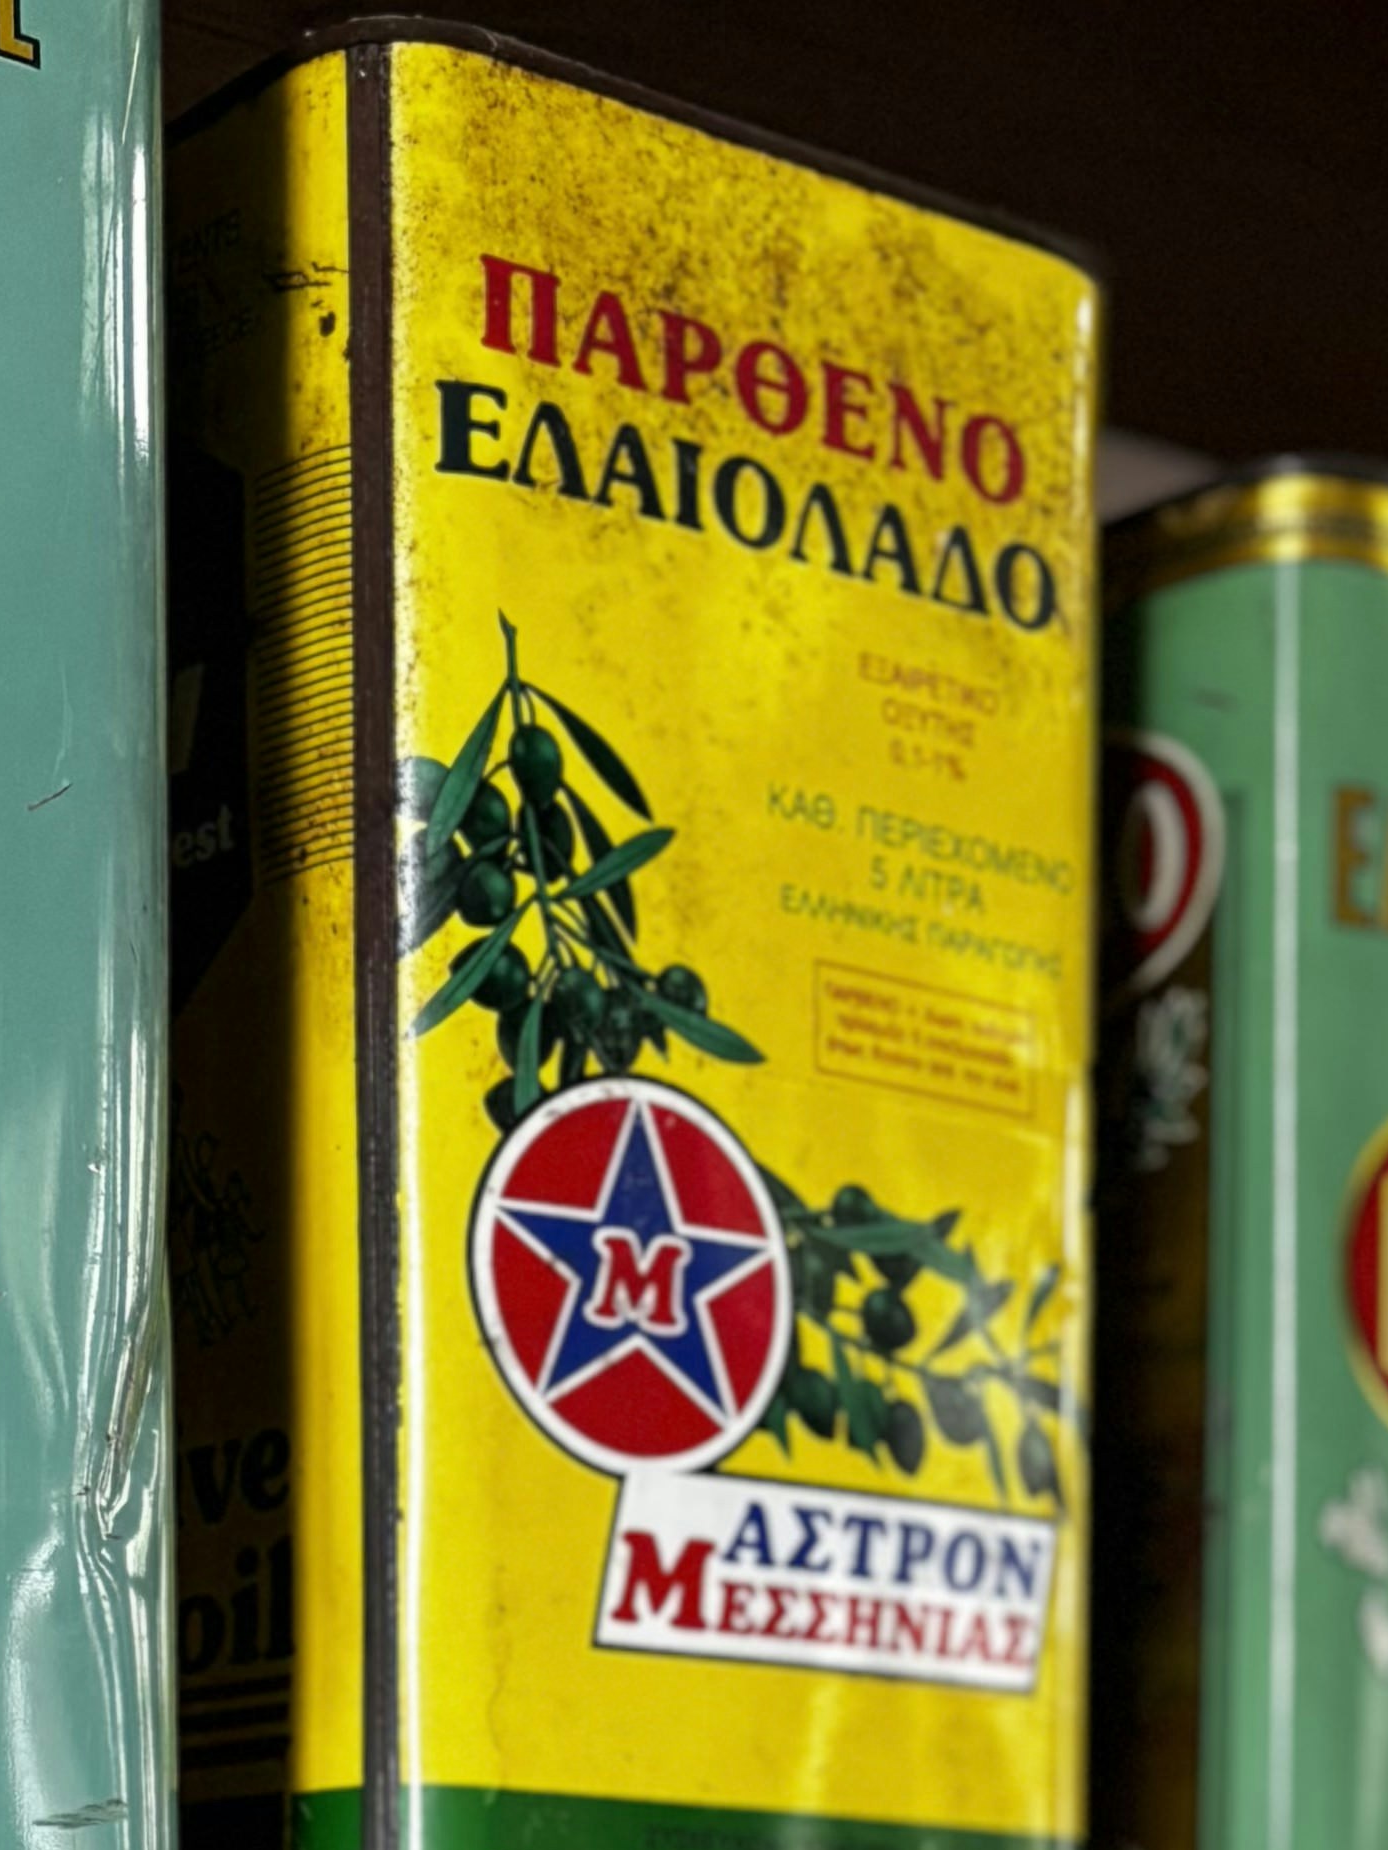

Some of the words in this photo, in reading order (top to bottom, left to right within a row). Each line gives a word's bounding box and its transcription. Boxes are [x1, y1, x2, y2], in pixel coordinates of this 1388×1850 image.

[481, 255, 1025, 505] ΠΑΡΘΕΝΟ
[436, 382, 1056, 633] ΕΛΑΙΟΛΑΔΟ
[612, 1530, 1035, 1668] ΜΕΣΣΗΝΙΑΣ
[722, 1502, 1043, 1600] ΑΣΤΡΟΝ
